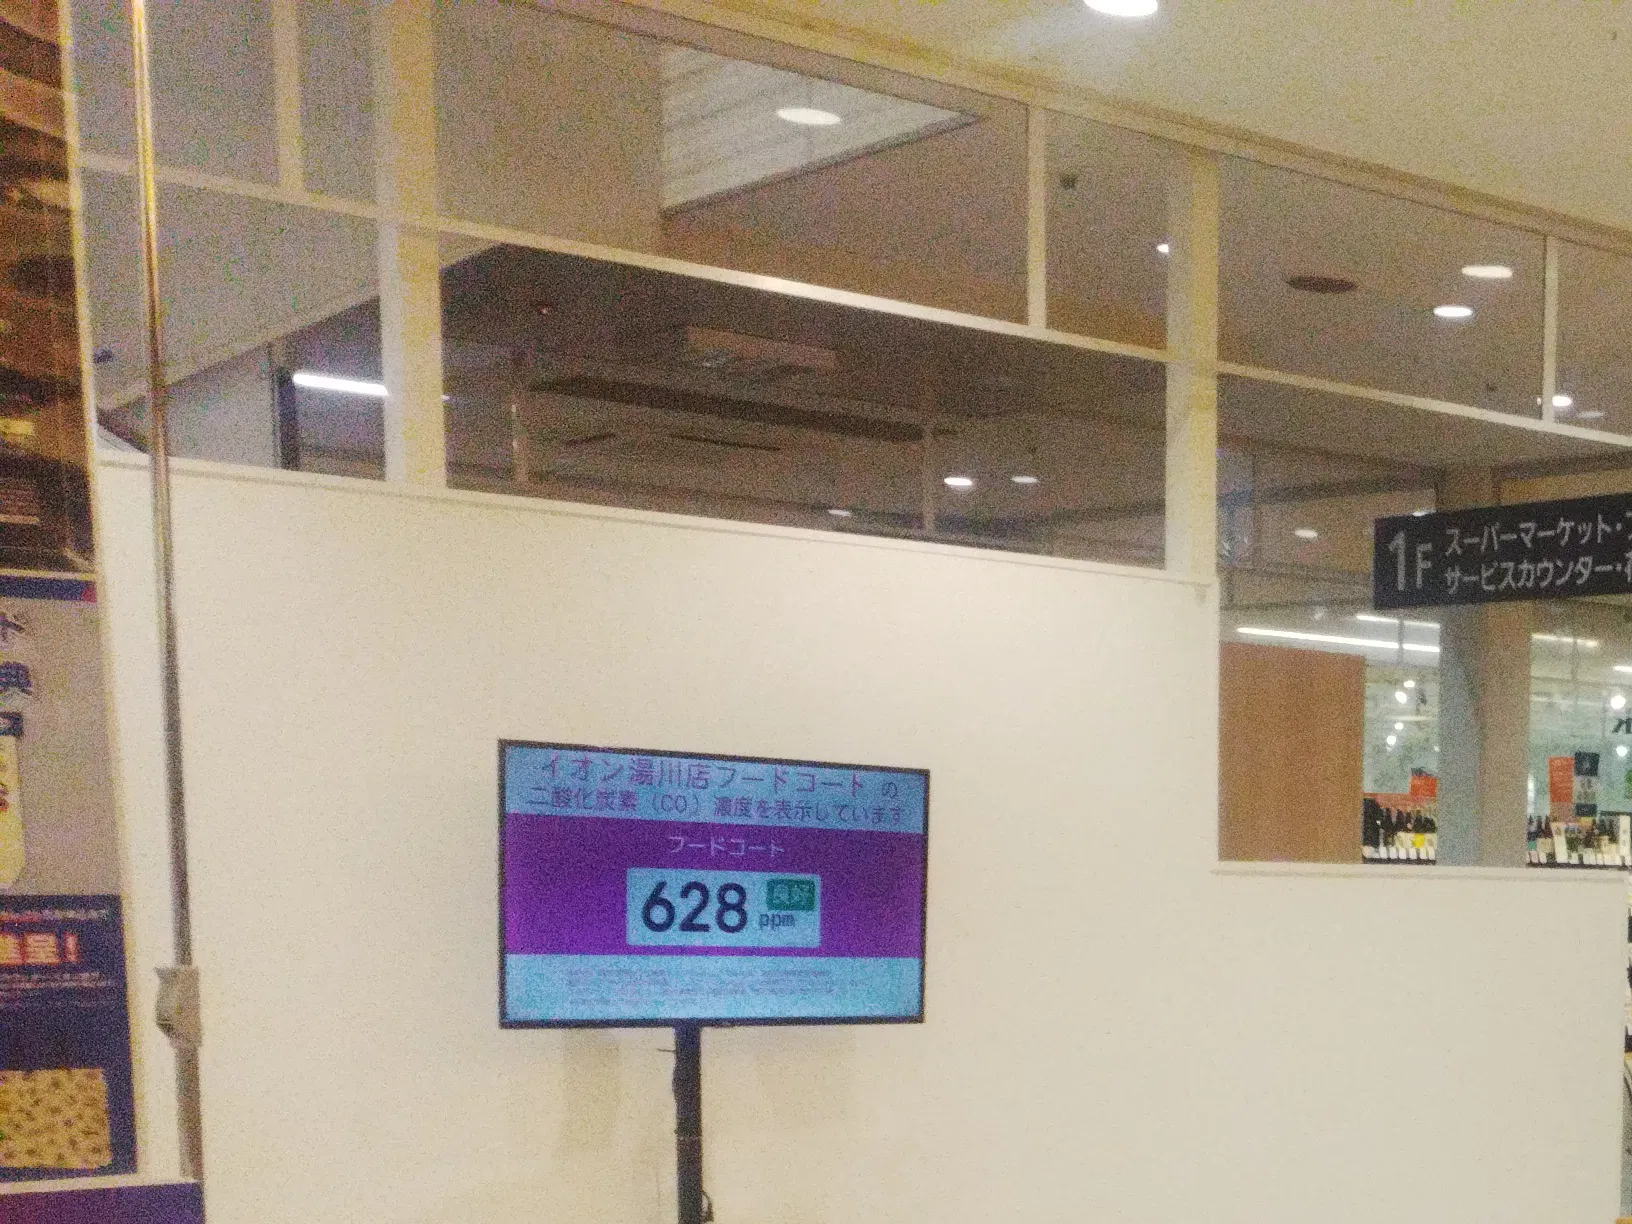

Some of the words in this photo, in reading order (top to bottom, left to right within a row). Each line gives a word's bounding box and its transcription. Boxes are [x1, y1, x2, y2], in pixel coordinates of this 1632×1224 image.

[668, 835, 786, 857] フードコート
[641, 881, 748, 933] 628
[758, 913, 796, 930] ppm
